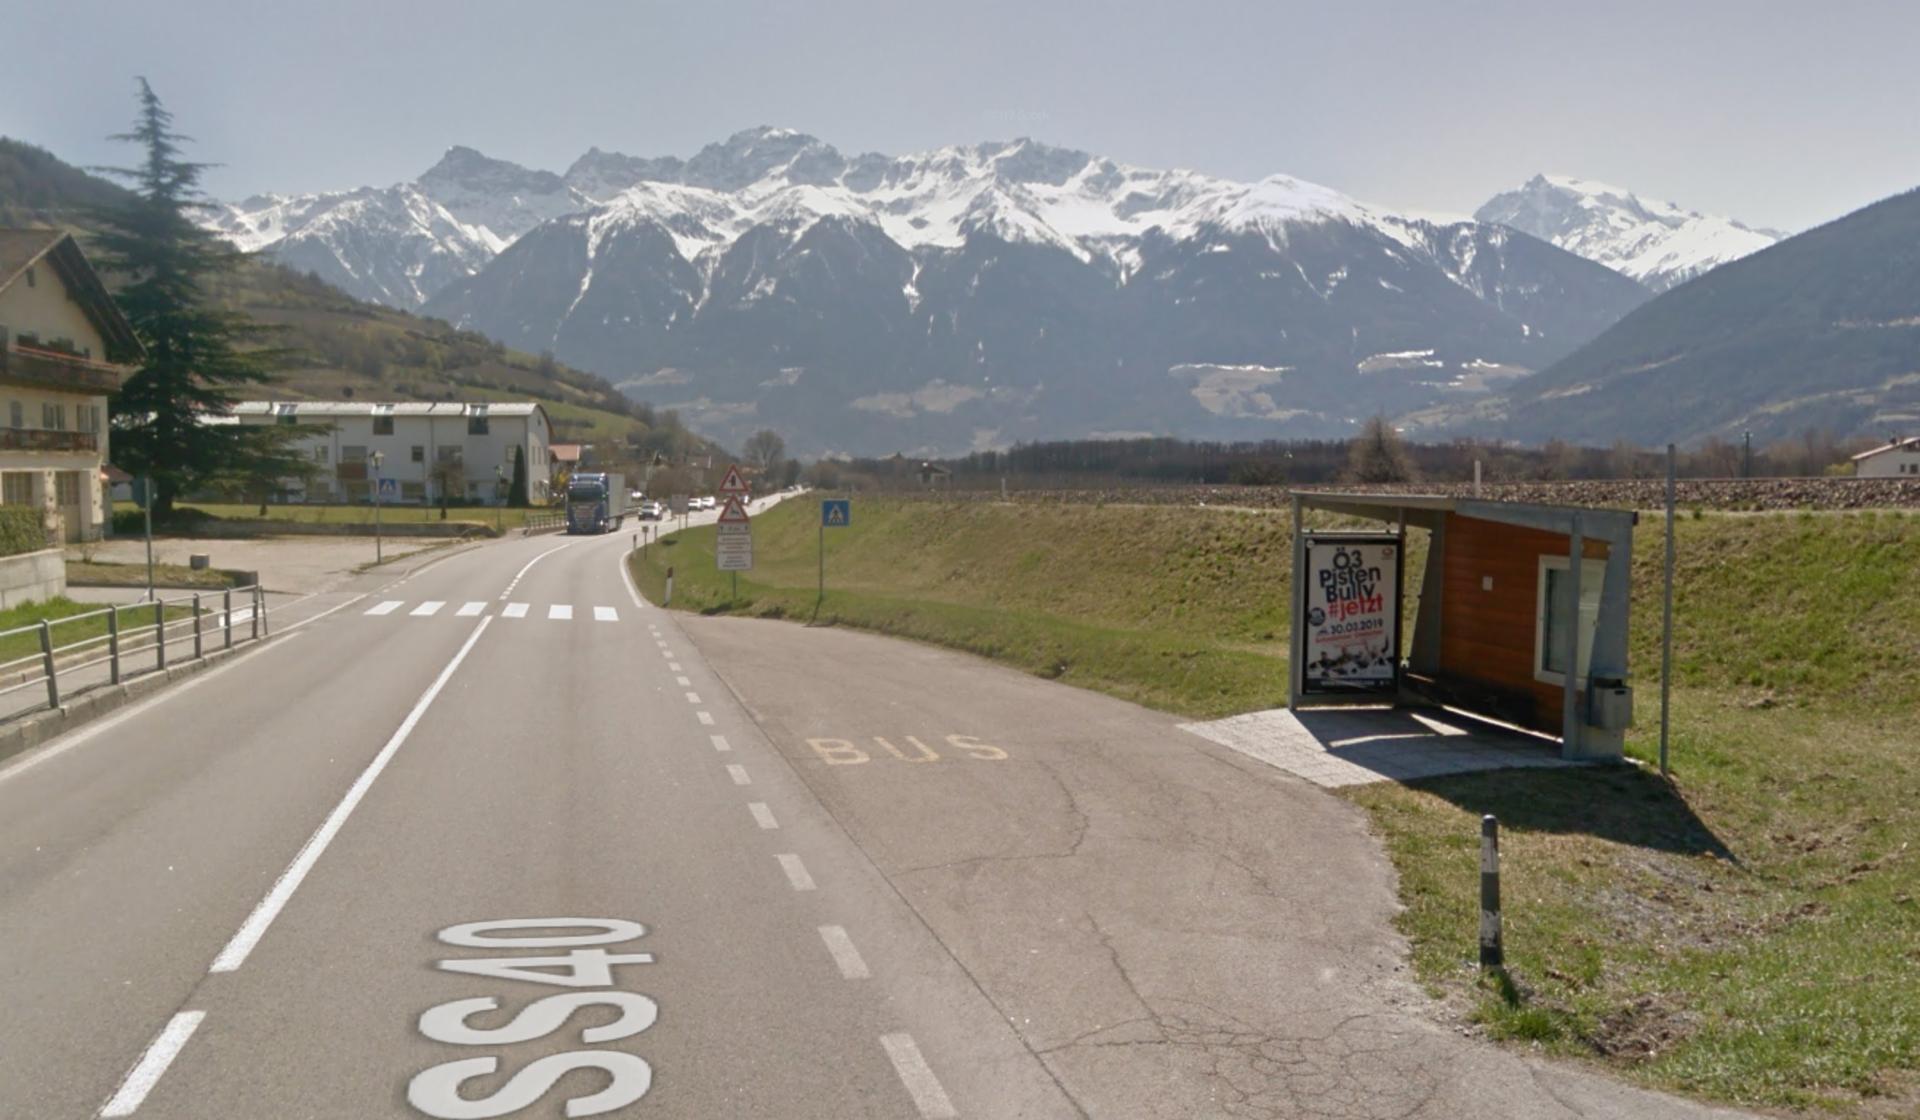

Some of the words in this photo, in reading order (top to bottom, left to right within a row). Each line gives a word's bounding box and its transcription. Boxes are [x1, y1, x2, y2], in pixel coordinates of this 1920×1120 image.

[1332, 546, 1363, 569] Ö3
[1319, 565, 1381, 588] Pisten
[1326, 581, 1375, 603] Bully
[1328, 592, 1383, 621] #jetzt
[805, 734, 1009, 766] BUS
